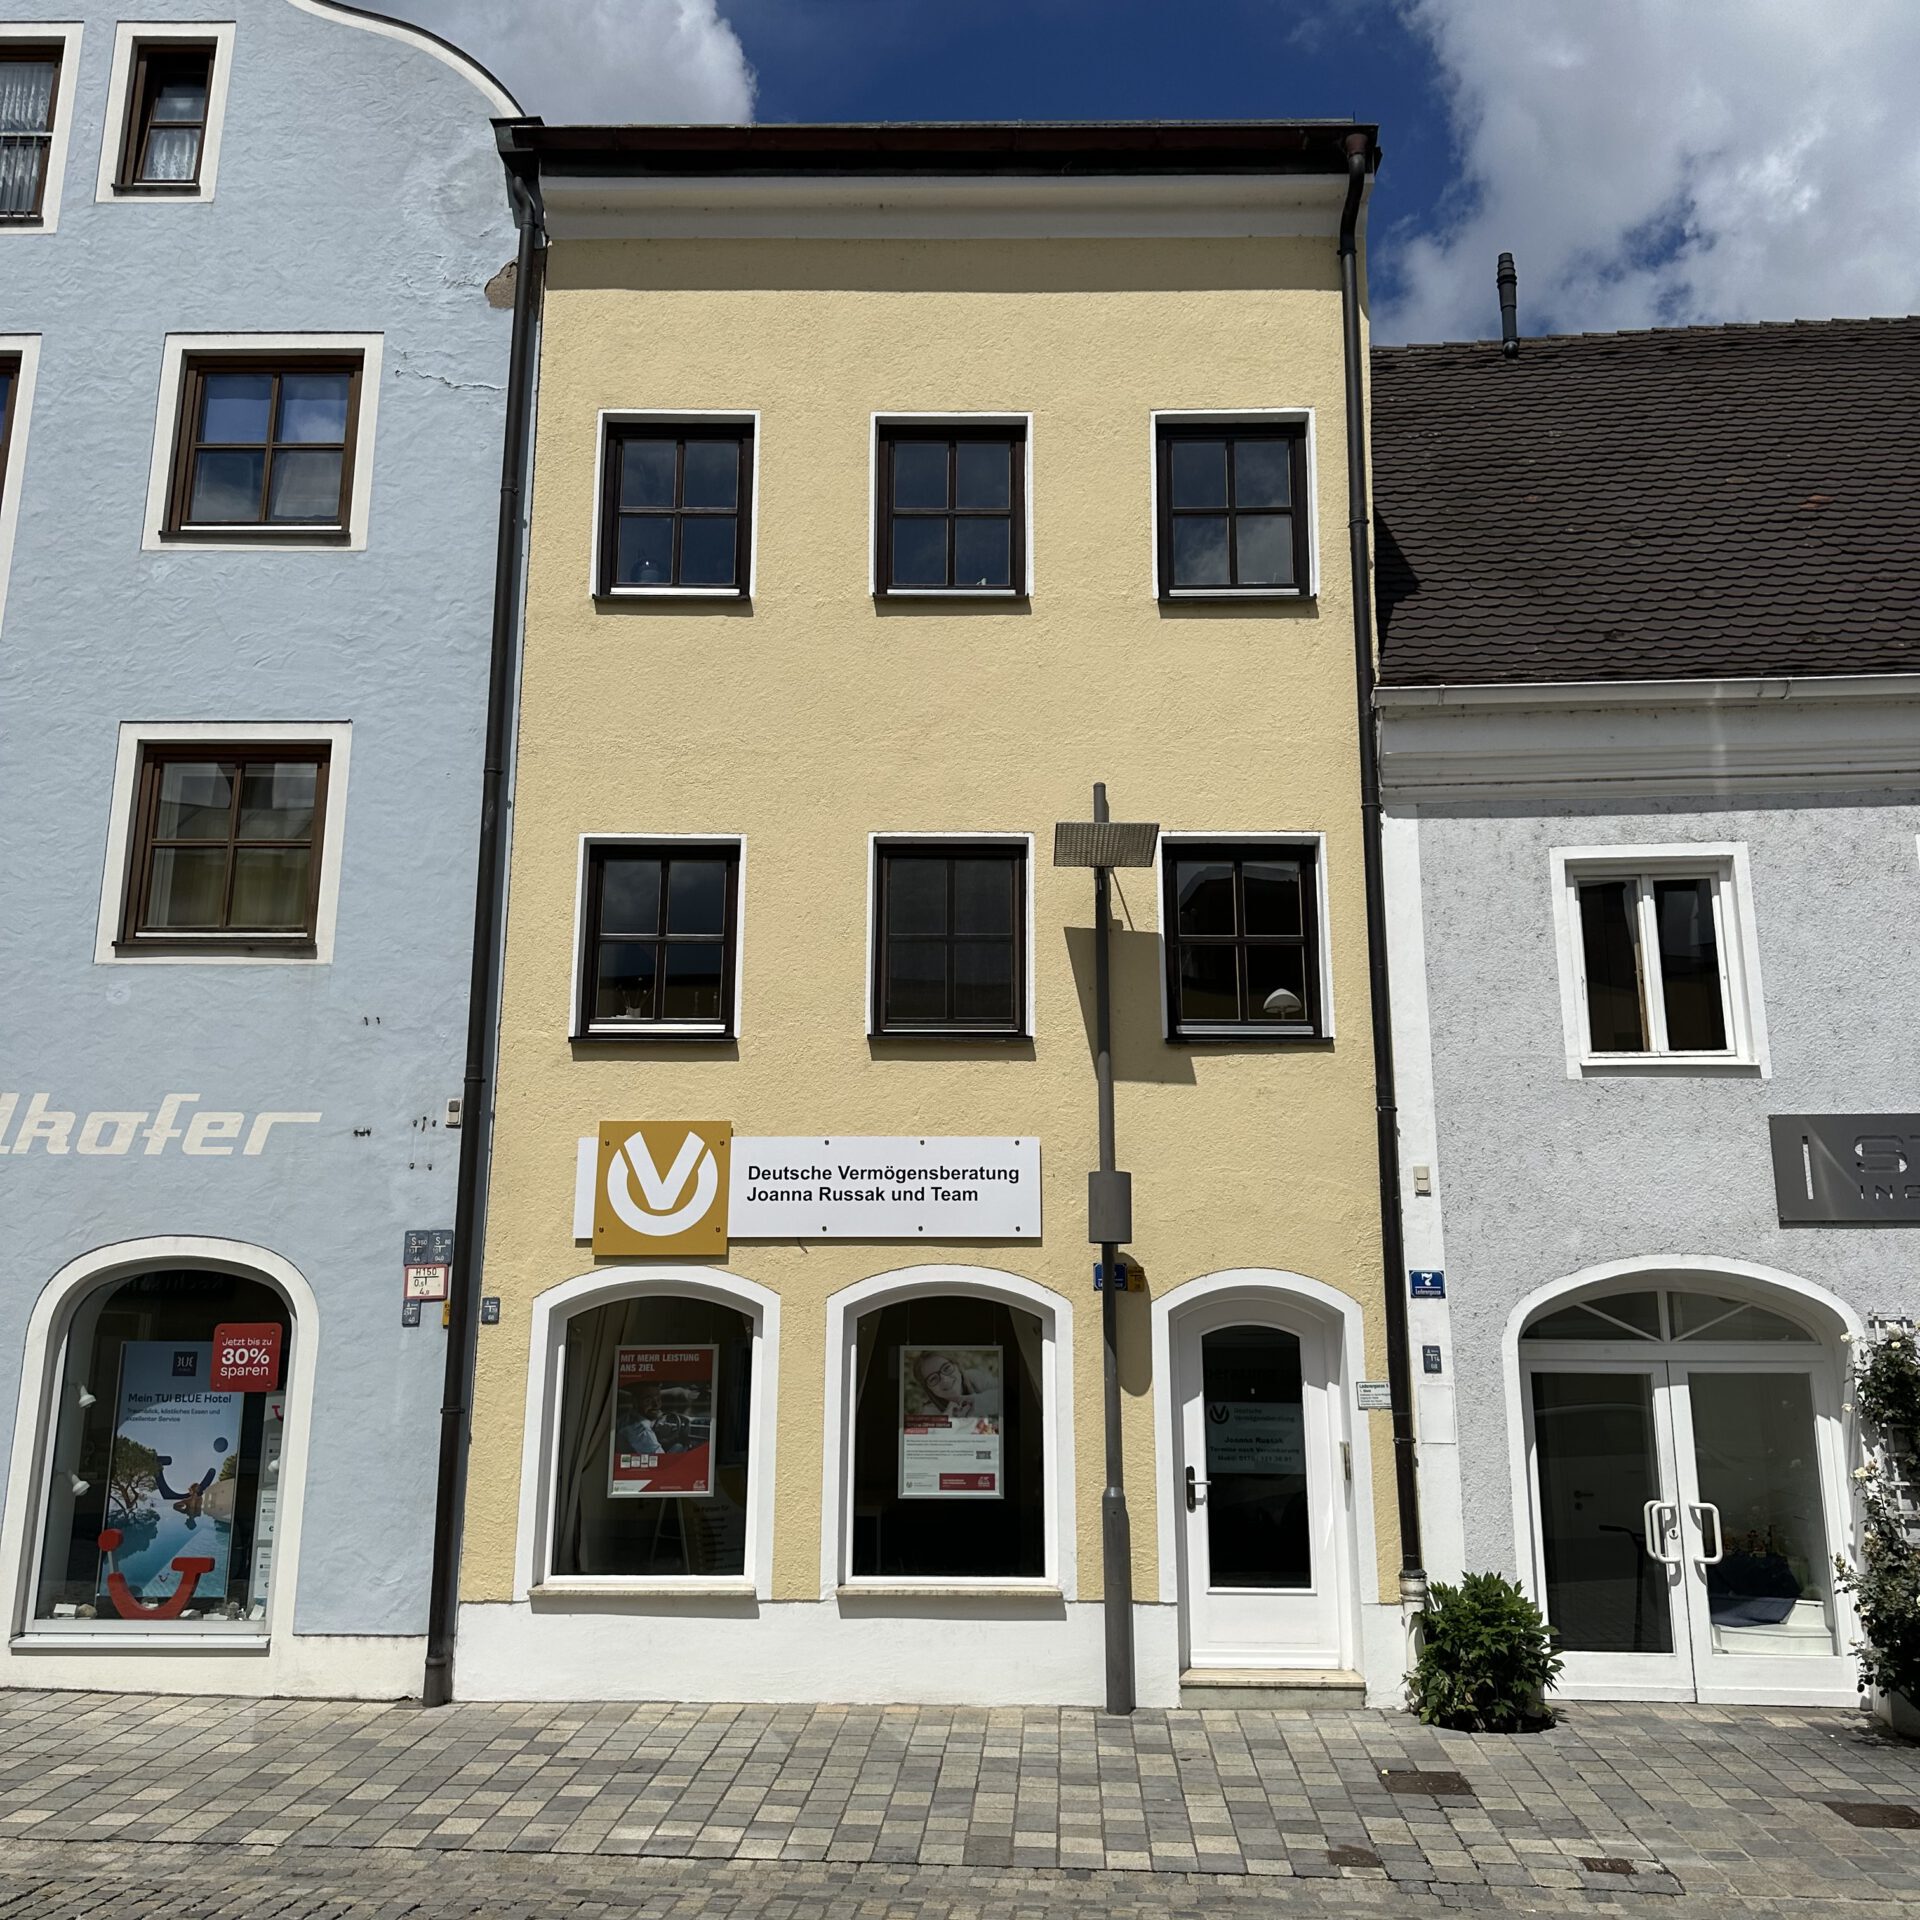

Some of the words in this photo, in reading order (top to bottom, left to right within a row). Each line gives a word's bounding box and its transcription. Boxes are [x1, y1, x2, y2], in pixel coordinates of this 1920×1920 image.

[748, 1165, 833, 1181] Deutsche
[837, 1165, 1020, 1184] Vermögensberatung
[746, 1187, 814, 1202] Joanna
[819, 1187, 886, 1202] Russak
[891, 1187, 926, 1202] und
[931, 1187, 979, 1202] Team
[1421, 1272, 1433, 1287] 7
[222, 1338, 246, 1346] Jetzt
[247, 1337, 260, 1346] bis
[262, 1338, 273, 1346] zu
[221, 1348, 270, 1365] 30%
[620, 1353, 636, 1362] MIT
[637, 1353, 660, 1362] MEHR
[662, 1353, 700, 1362] LEISTUNG
[220, 1366, 269, 1379] sparen
[620, 1363, 636, 1372] ANS
[638, 1363, 655, 1372] ZIEL
[128, 1393, 153, 1404] Mein
[154, 1393, 172, 1404] TUI
[174, 1393, 202, 1404] BLUE
[203, 1393, 232, 1404] Hotel
